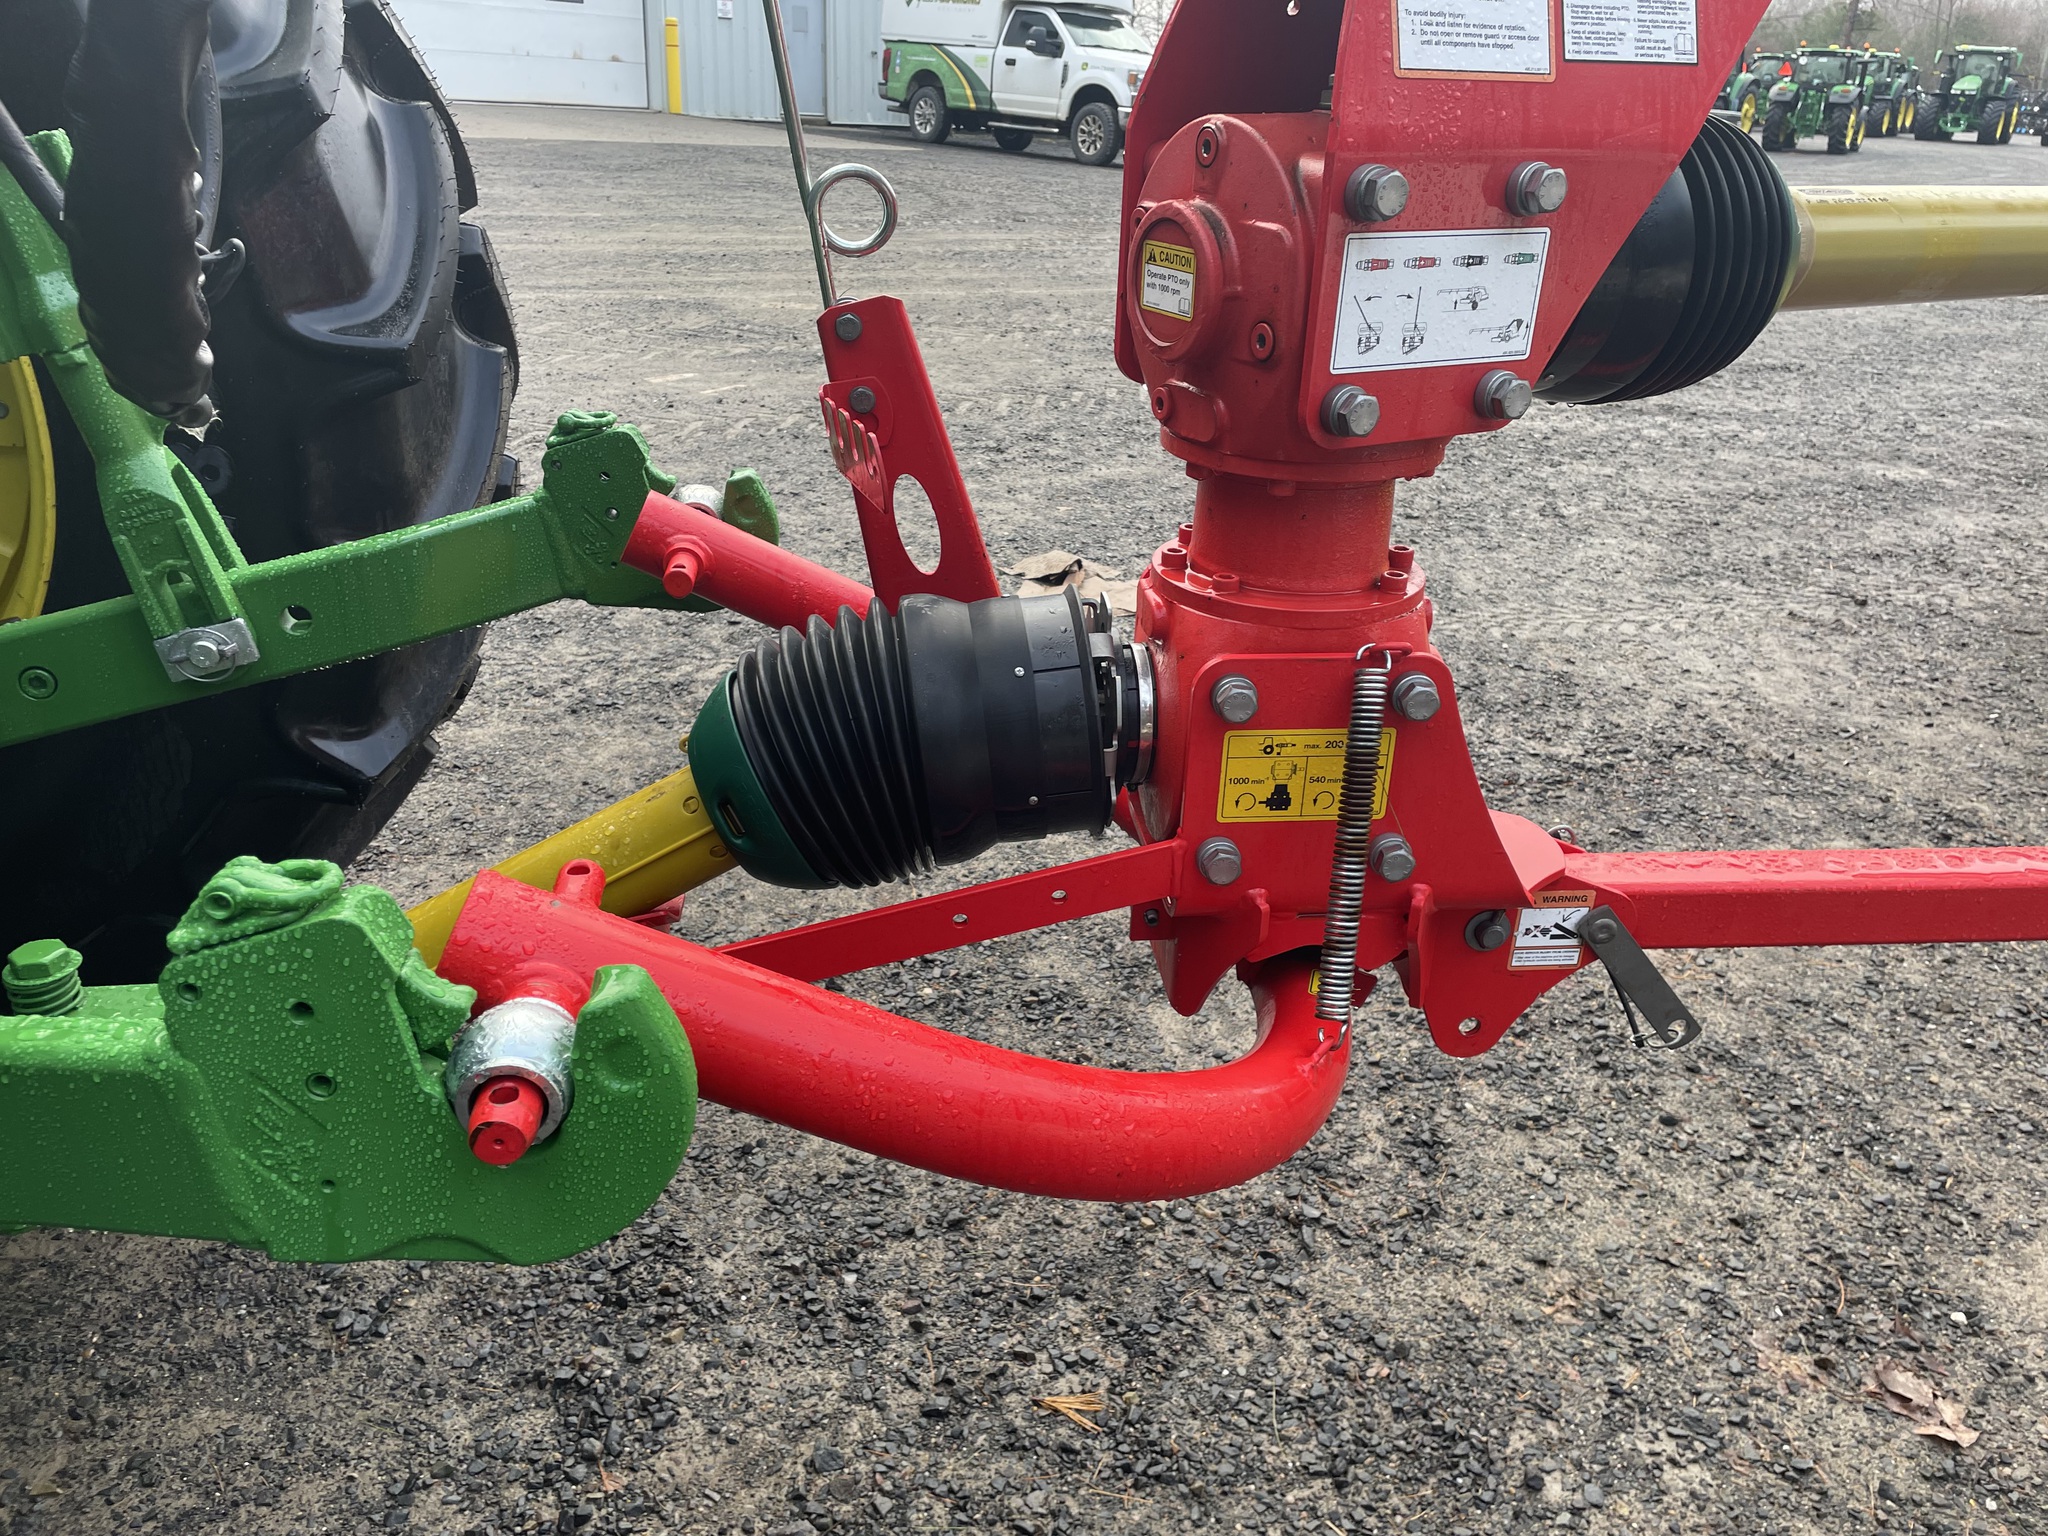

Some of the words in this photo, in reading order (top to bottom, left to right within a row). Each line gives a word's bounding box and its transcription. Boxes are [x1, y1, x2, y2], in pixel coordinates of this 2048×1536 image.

[1430, 11, 1446, 19] bodily
[1160, 250, 1192, 268] CAUTION
[1147, 269, 1166, 280] Operate
[1168, 274, 1178, 284] PTO
[1179, 278, 1190, 288] only
[1158, 284, 1170, 293] 1000
[1171, 288, 1180, 296] rpm
[1542, 895, 1588, 903] WARNING
